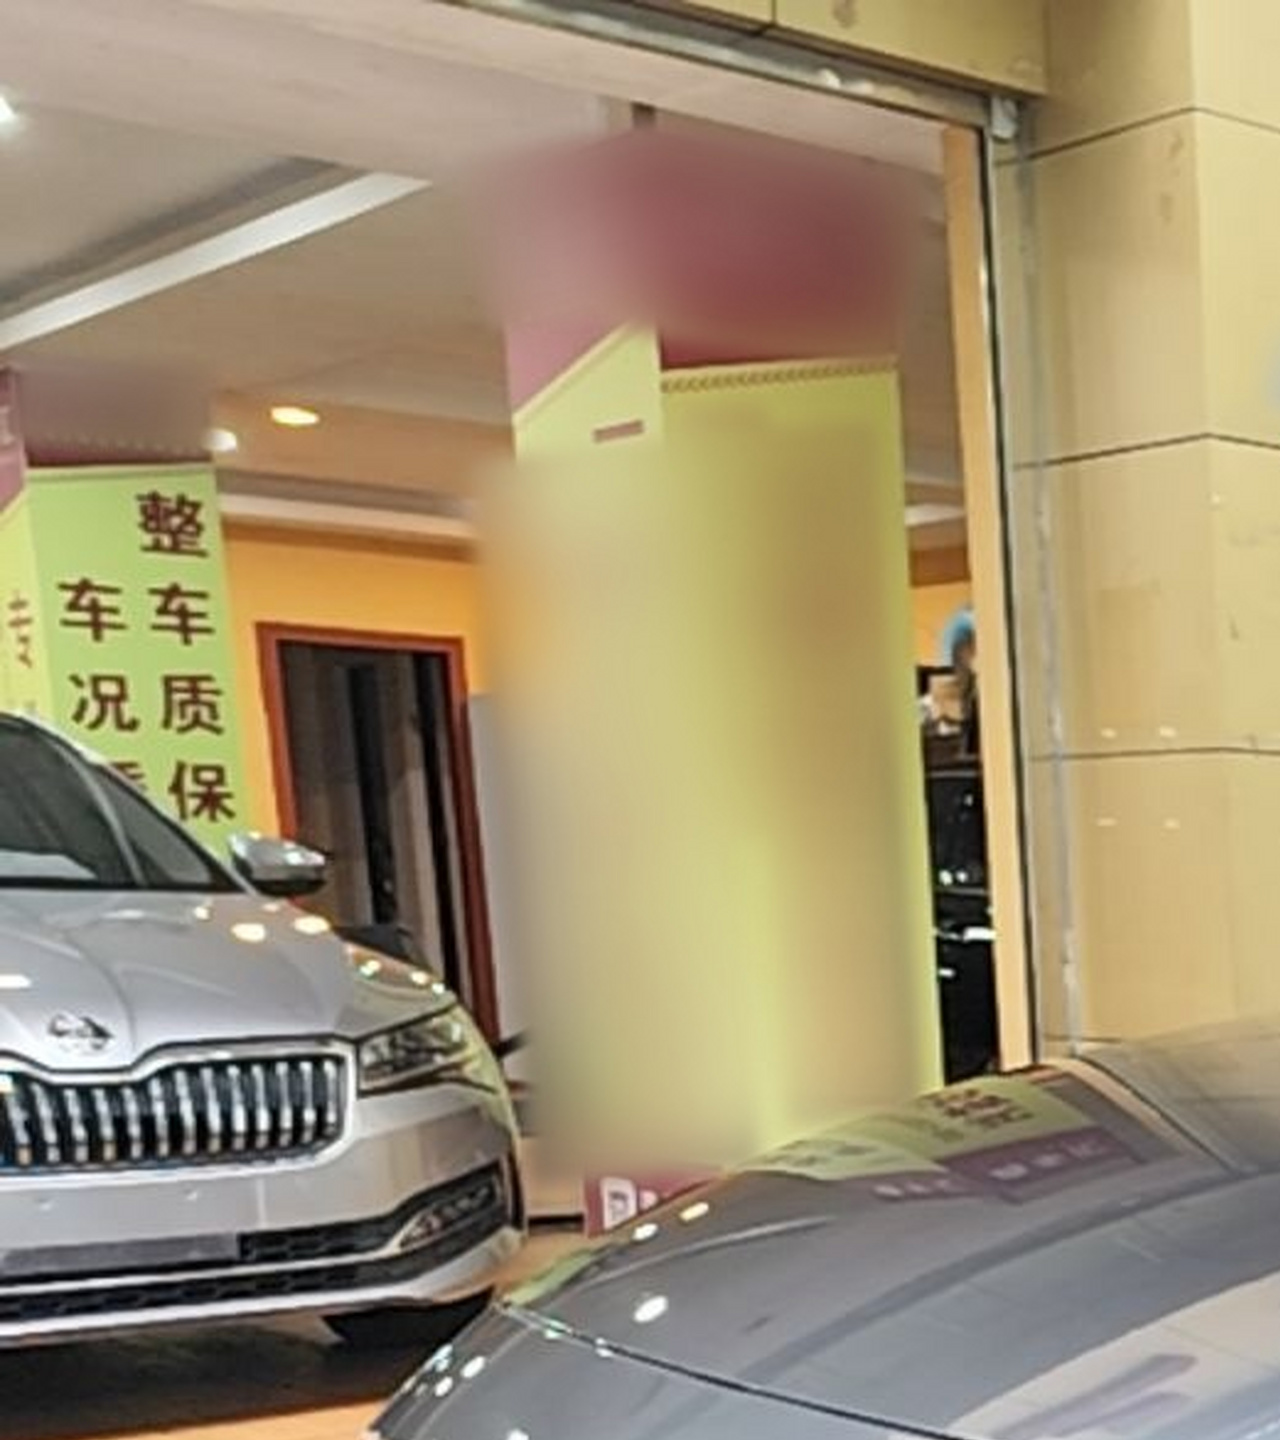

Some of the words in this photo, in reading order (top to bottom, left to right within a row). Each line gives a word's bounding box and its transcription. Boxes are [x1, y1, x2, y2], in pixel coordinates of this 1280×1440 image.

[57, 577, 146, 790] 车况
[136, 490, 235, 823] 整车质保
